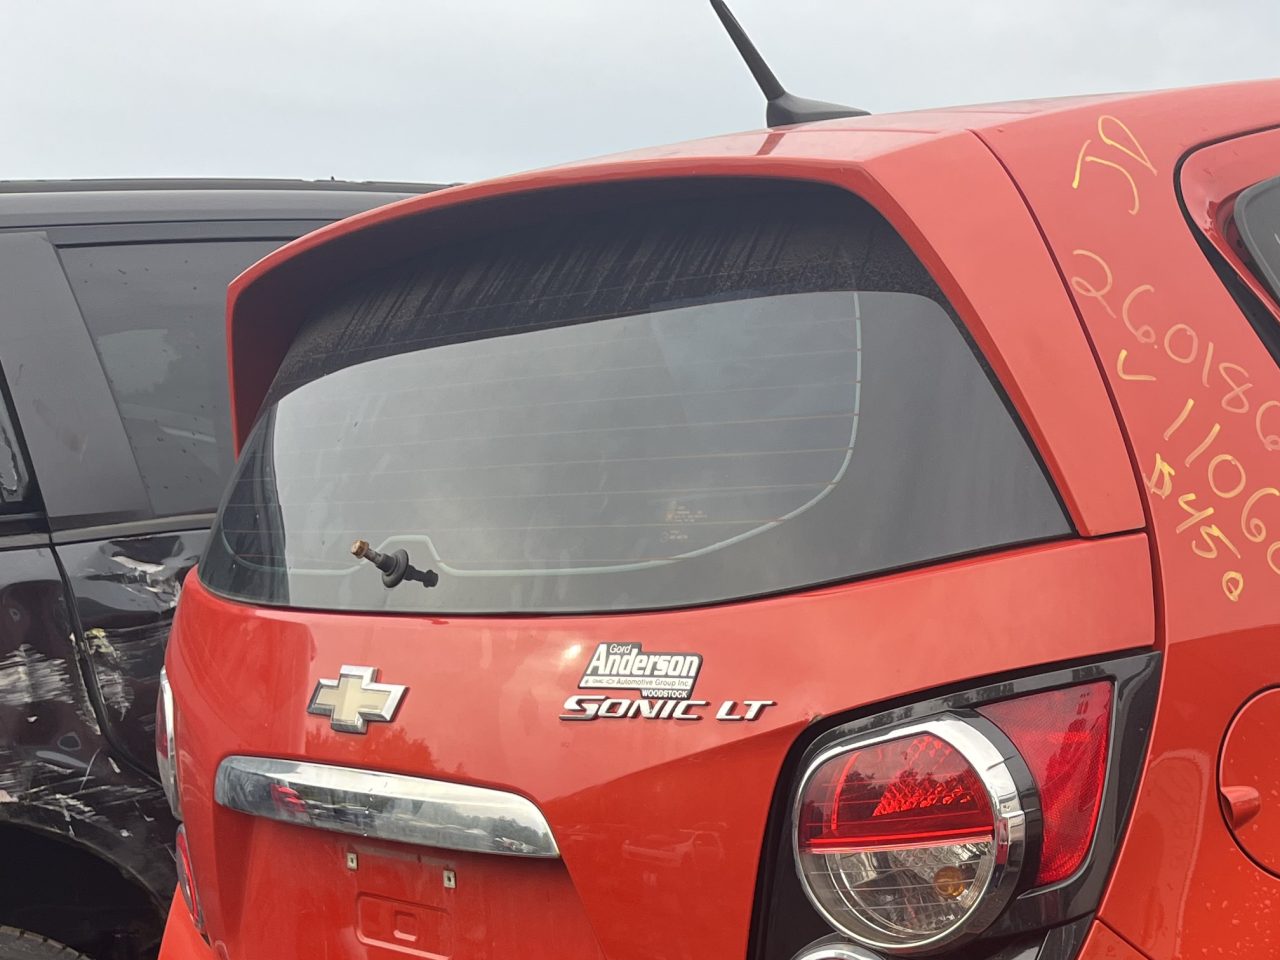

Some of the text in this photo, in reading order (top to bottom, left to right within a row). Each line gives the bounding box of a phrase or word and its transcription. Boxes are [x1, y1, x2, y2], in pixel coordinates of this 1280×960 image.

[609, 643, 632, 654] Gord
[585, 643, 700, 677] Anderson
[616, 678, 653, 686] Automotive
[654, 679, 677, 688] Group
[641, 689, 689, 698] WOODSTOCK
[559, 695, 776, 721] SONIC LT
